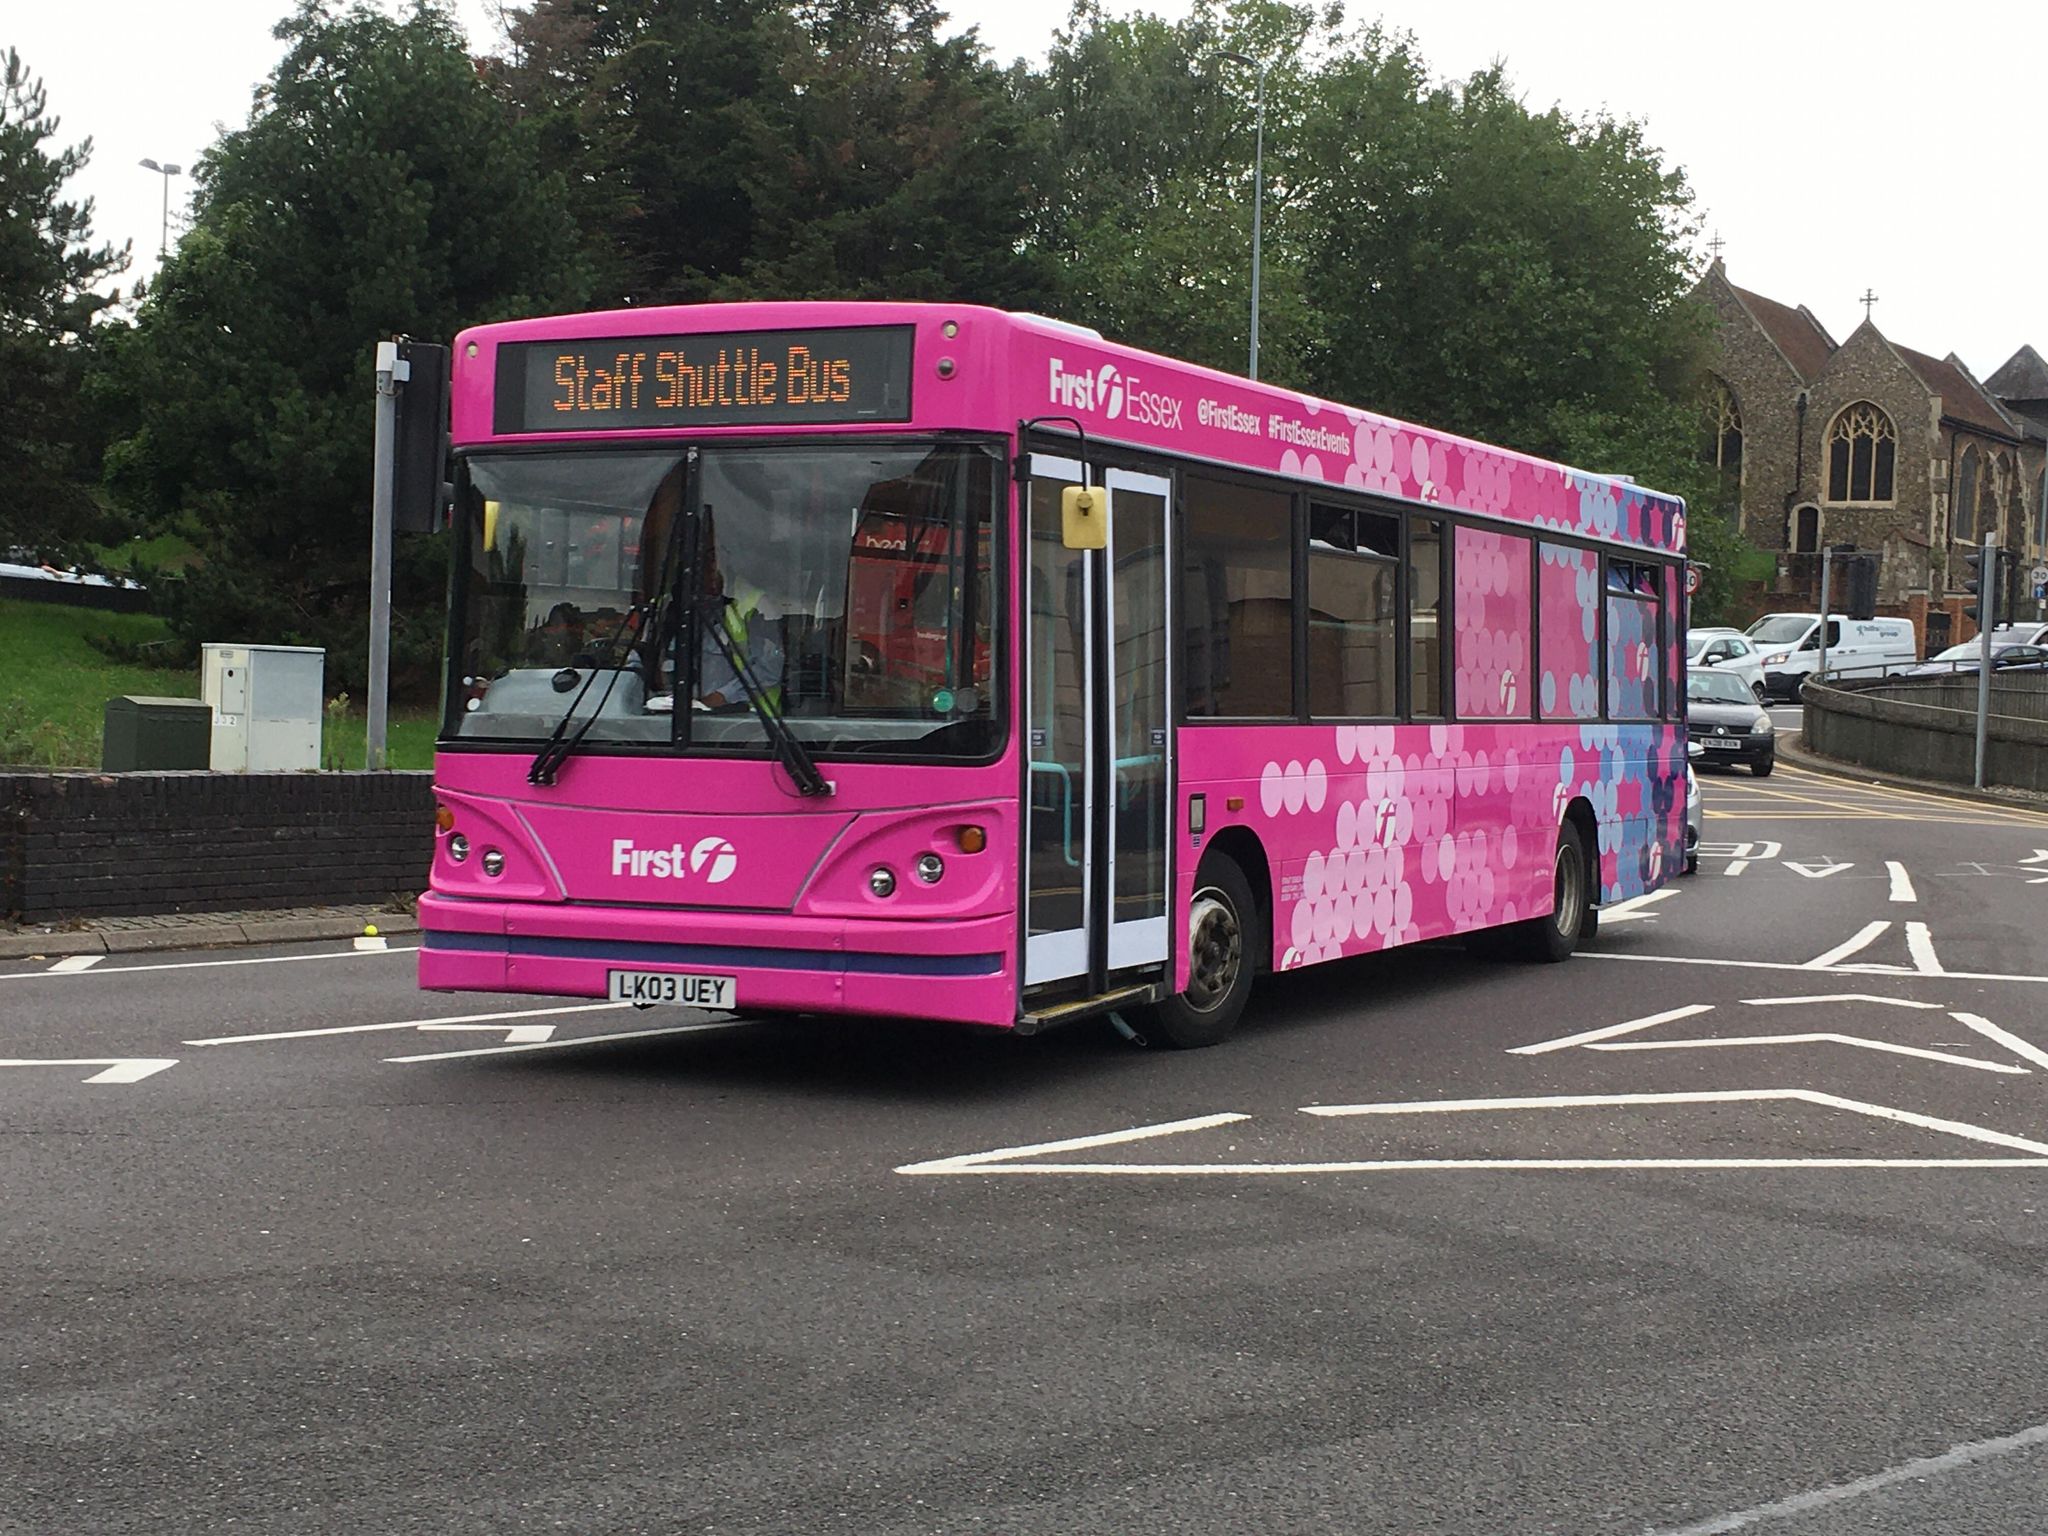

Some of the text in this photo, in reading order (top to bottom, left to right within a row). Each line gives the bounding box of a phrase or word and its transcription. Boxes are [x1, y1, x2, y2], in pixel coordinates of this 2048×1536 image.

[553, 346, 850, 410] Staff Shuttle Bus
[1049, 357, 1184, 431] First Essex
[1198, 398, 1350, 457] @FirstEssex #FirstEssexEvents
[612, 839, 686, 879] First
[619, 974, 726, 1004] LK03 UEY
